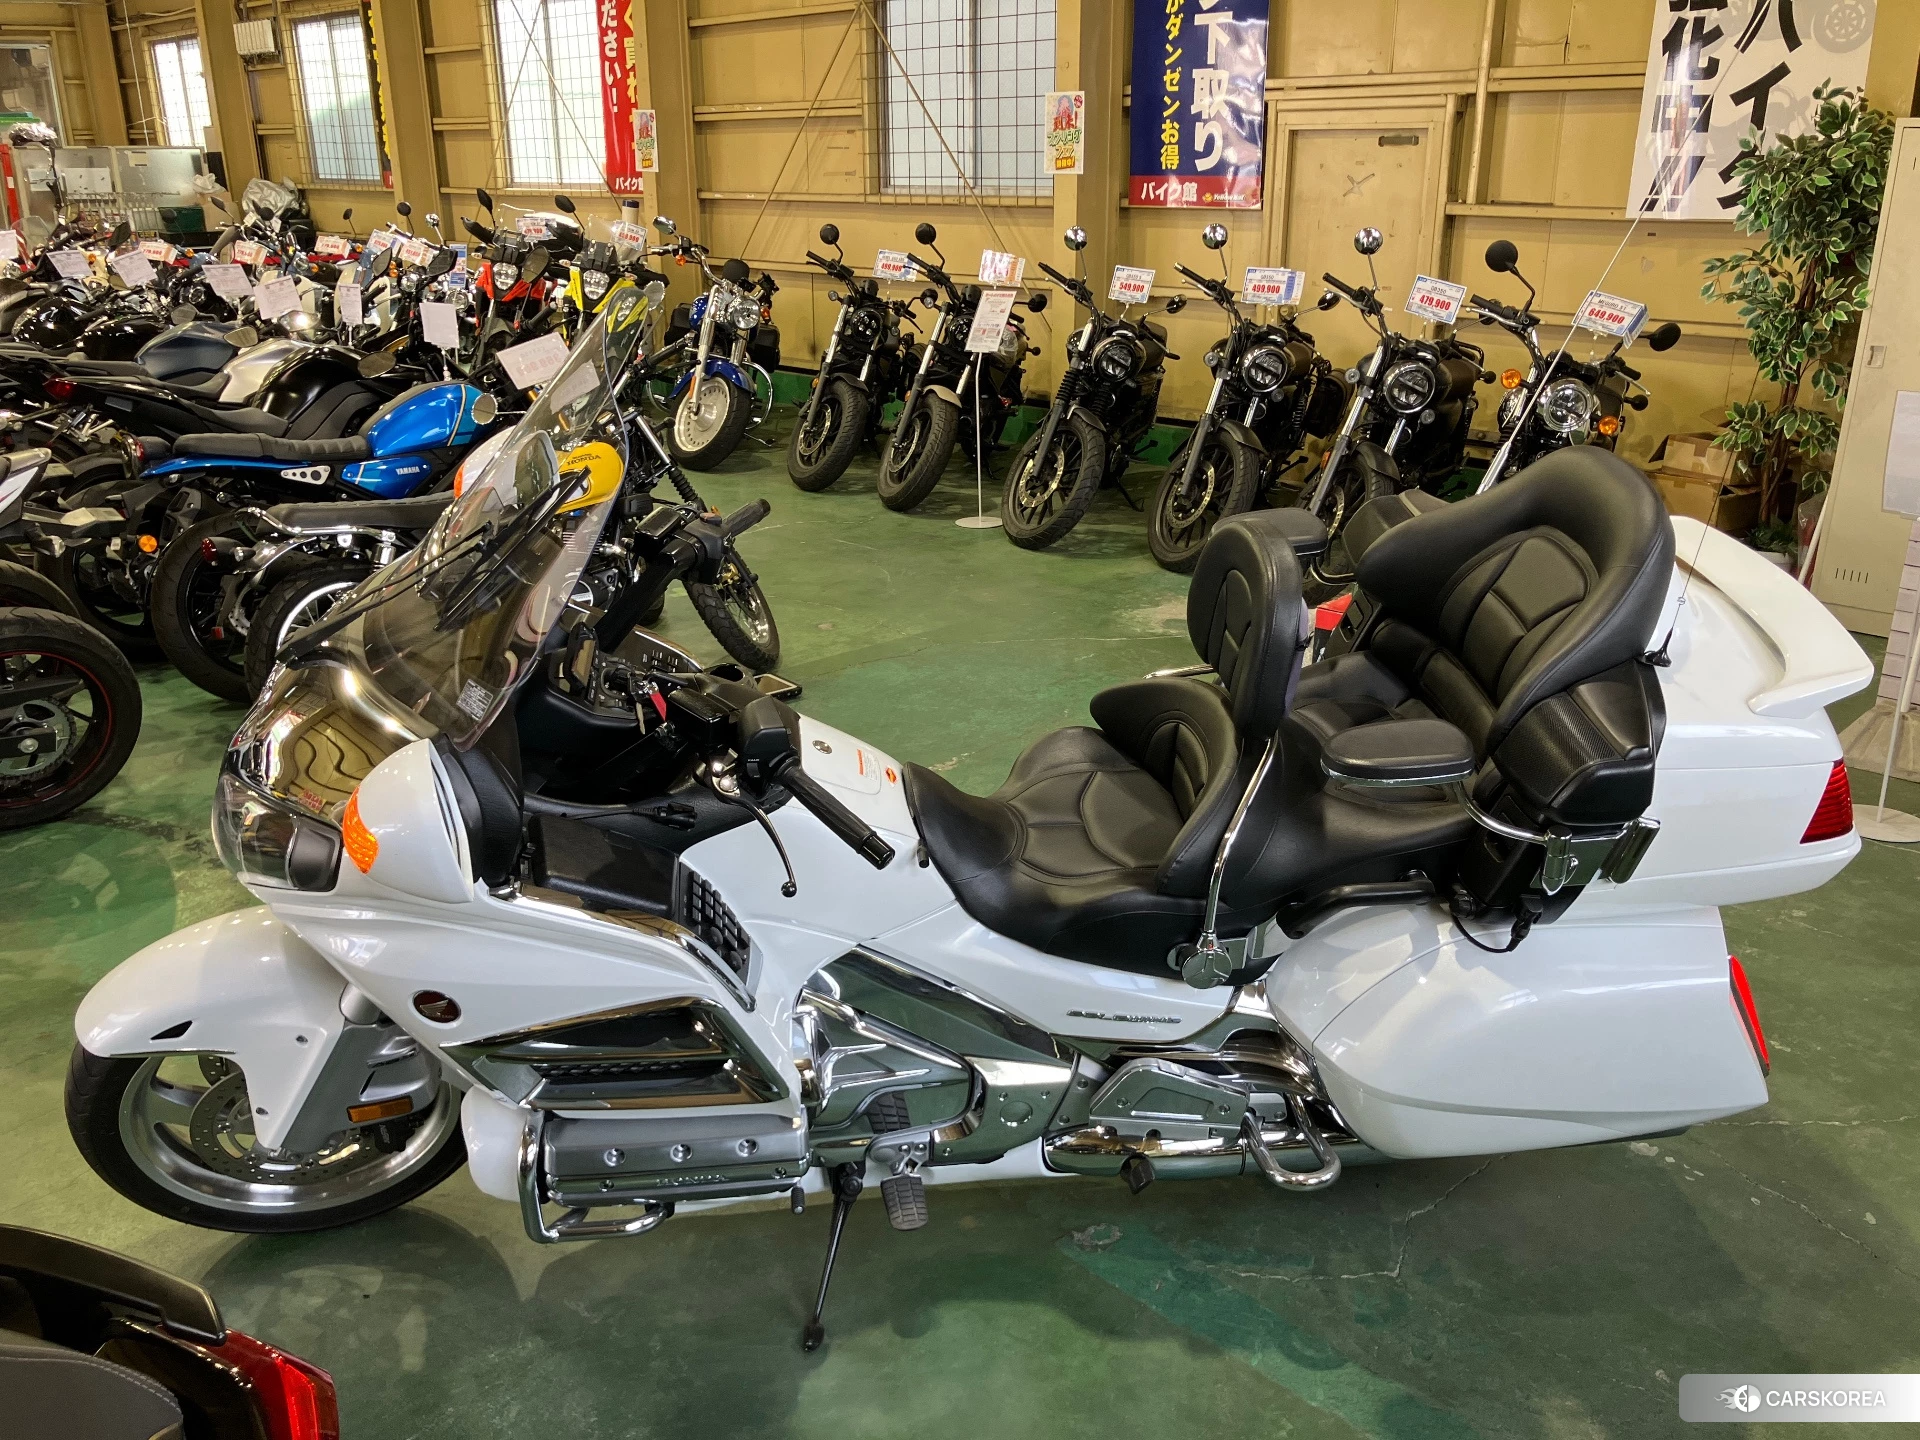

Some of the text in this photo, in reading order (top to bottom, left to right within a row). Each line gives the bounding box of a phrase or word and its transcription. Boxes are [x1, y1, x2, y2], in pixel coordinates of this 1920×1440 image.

[1190, 0, 1233, 172] 下取り
[1141, 181, 1198, 202] バイク館
[1119, 282, 1145, 293] 549,900
[1252, 284, 1280, 294] 499,900
[1420, 295, 1451, 311] 479,900
[1588, 308, 1625, 324] 649,900
[566, 454, 602, 466] HONDA
[395, 466, 420, 475] YAMAHA
